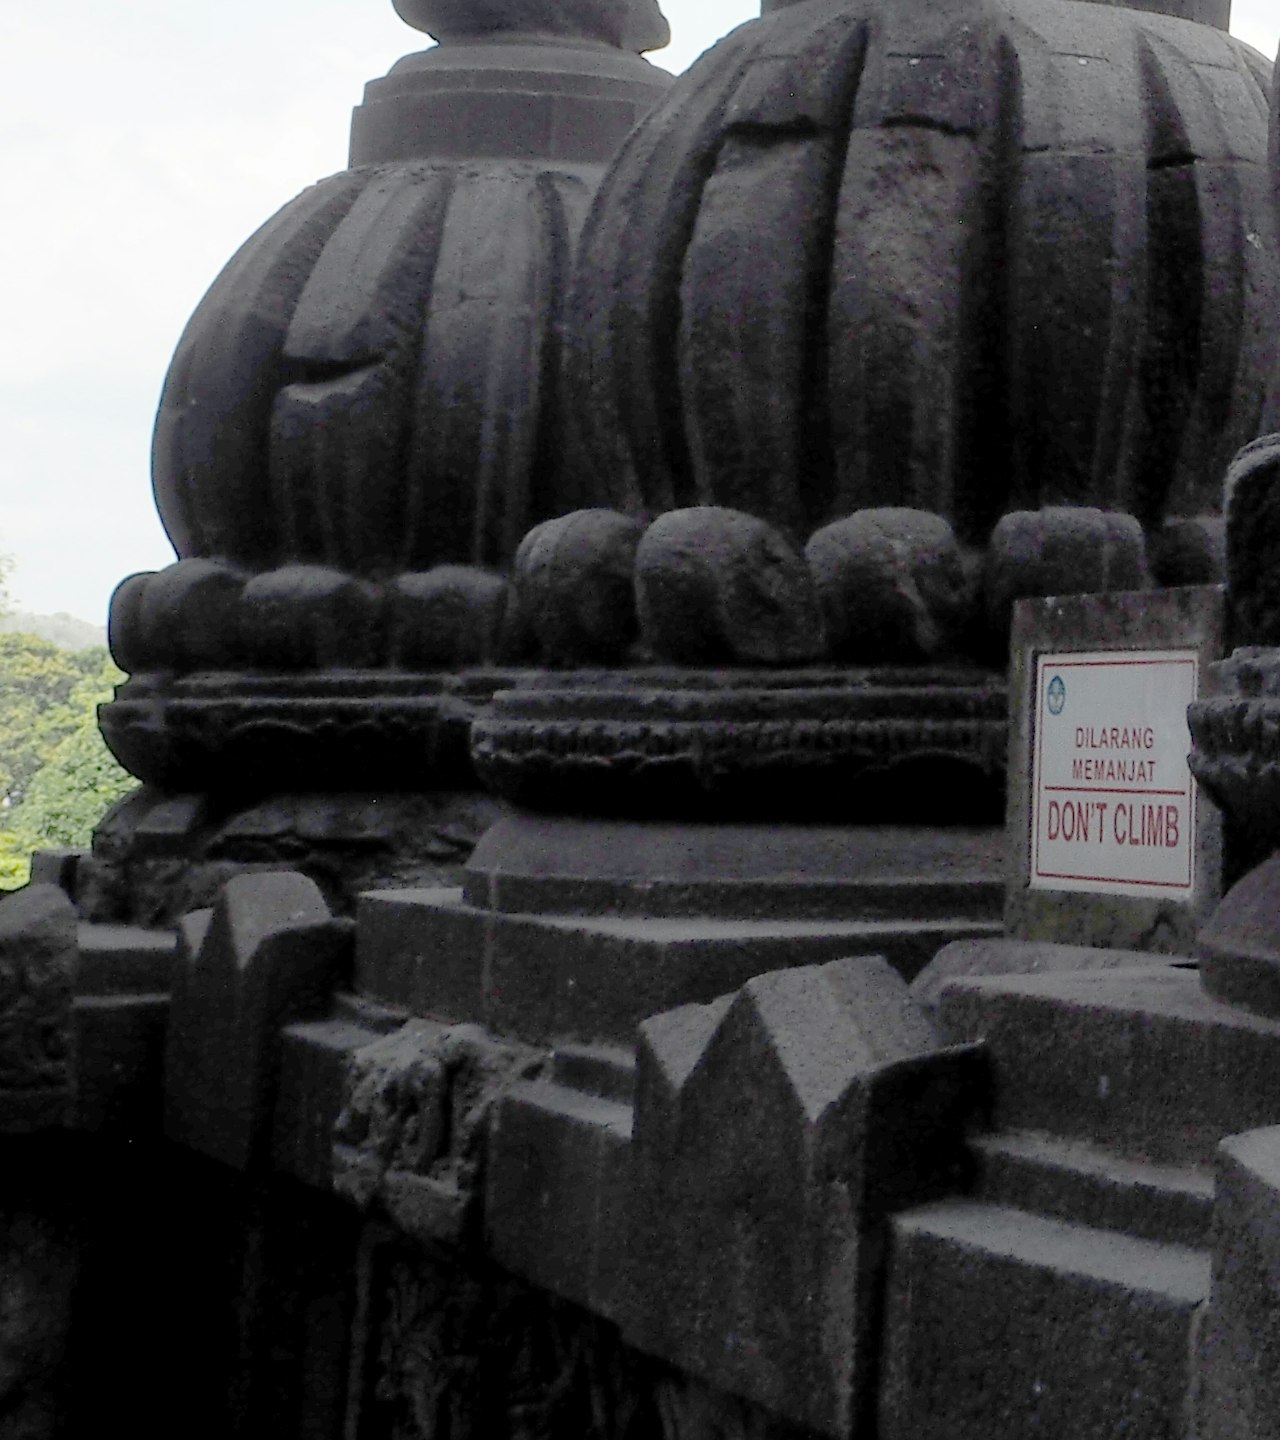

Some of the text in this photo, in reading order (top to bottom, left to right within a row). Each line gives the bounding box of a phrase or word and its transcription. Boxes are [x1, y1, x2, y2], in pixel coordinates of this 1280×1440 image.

[1075, 726, 1154, 750] DILARANG
[1072, 759, 1156, 782] MEMANJAT
[1047, 800, 1180, 848] DON'T CLIMB
